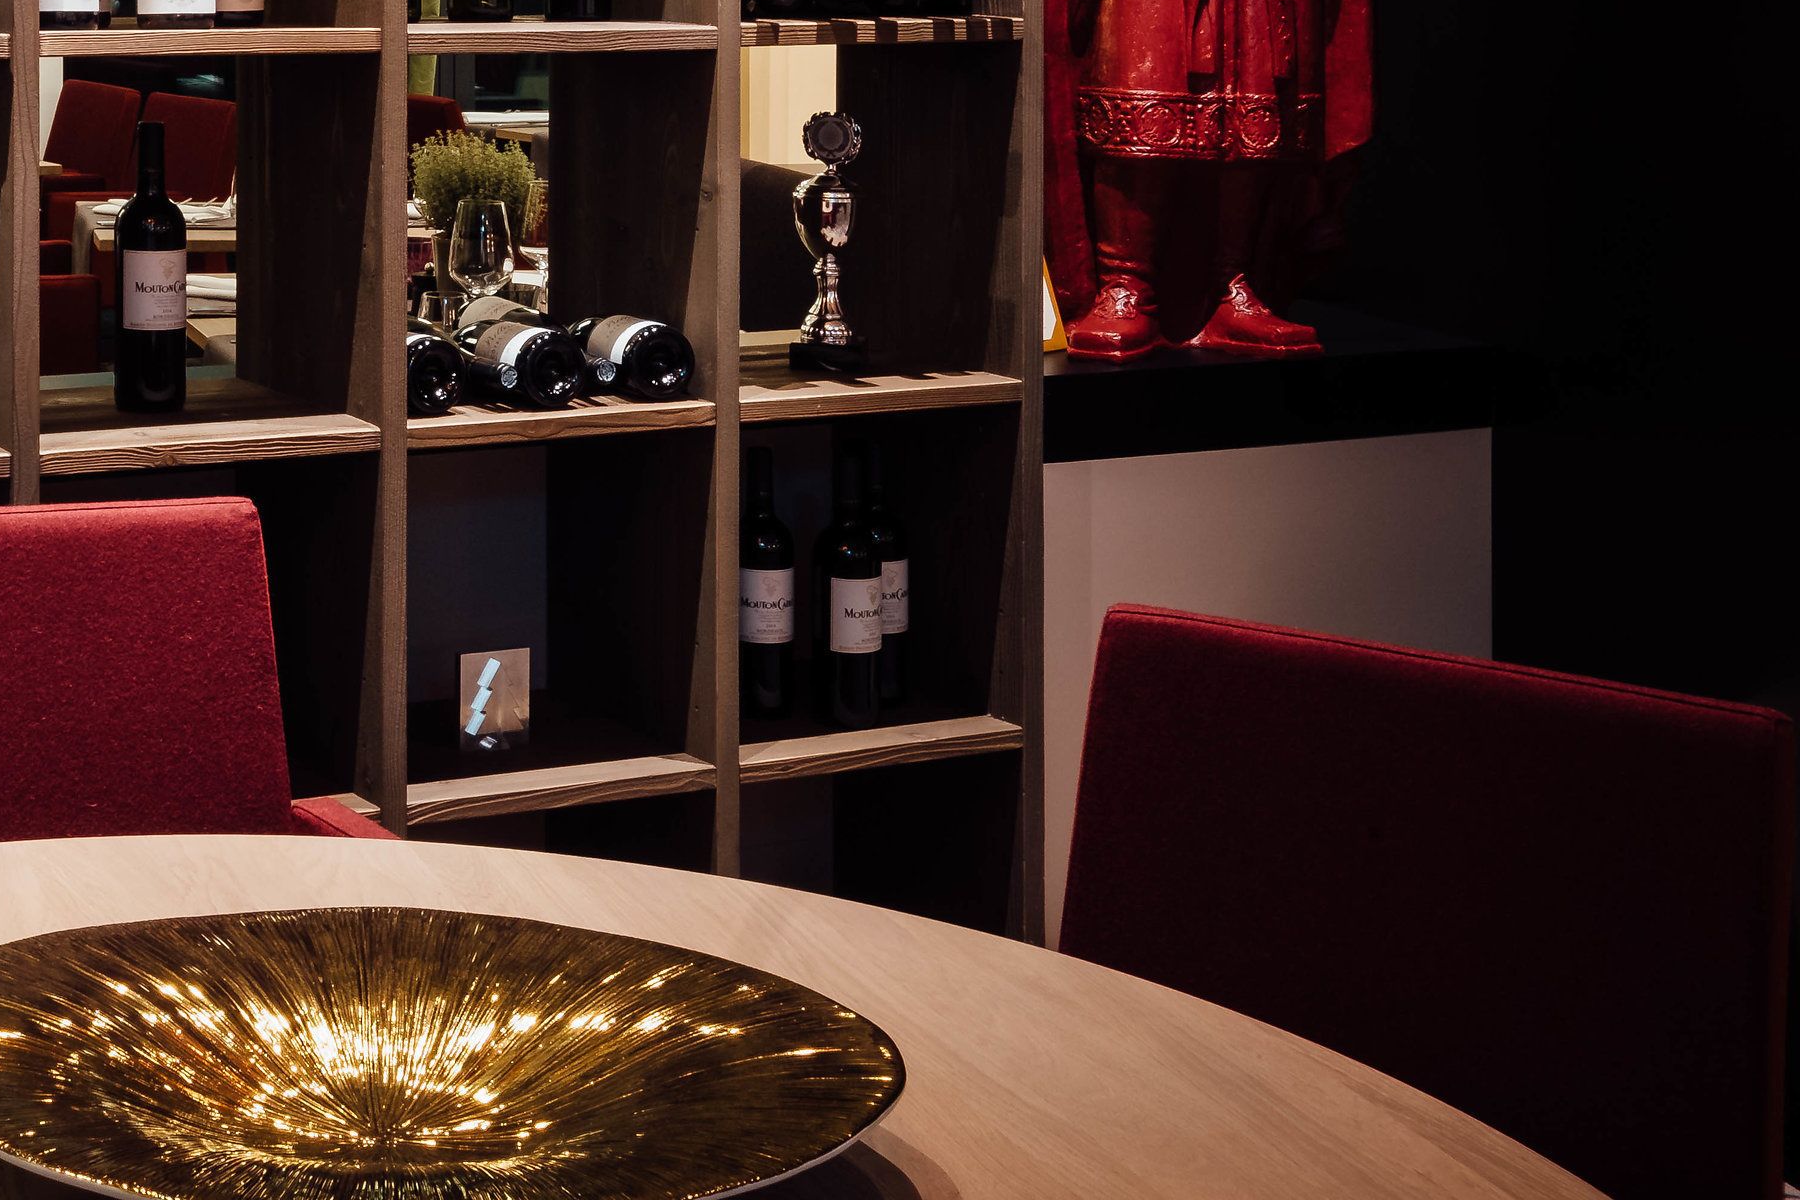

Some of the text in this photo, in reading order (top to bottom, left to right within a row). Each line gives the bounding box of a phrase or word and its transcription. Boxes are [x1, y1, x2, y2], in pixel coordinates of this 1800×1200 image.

[135, 281, 175, 293] MOUTON
[741, 596, 778, 609] MOUTON
[844, 607, 879, 619] MOUTON
